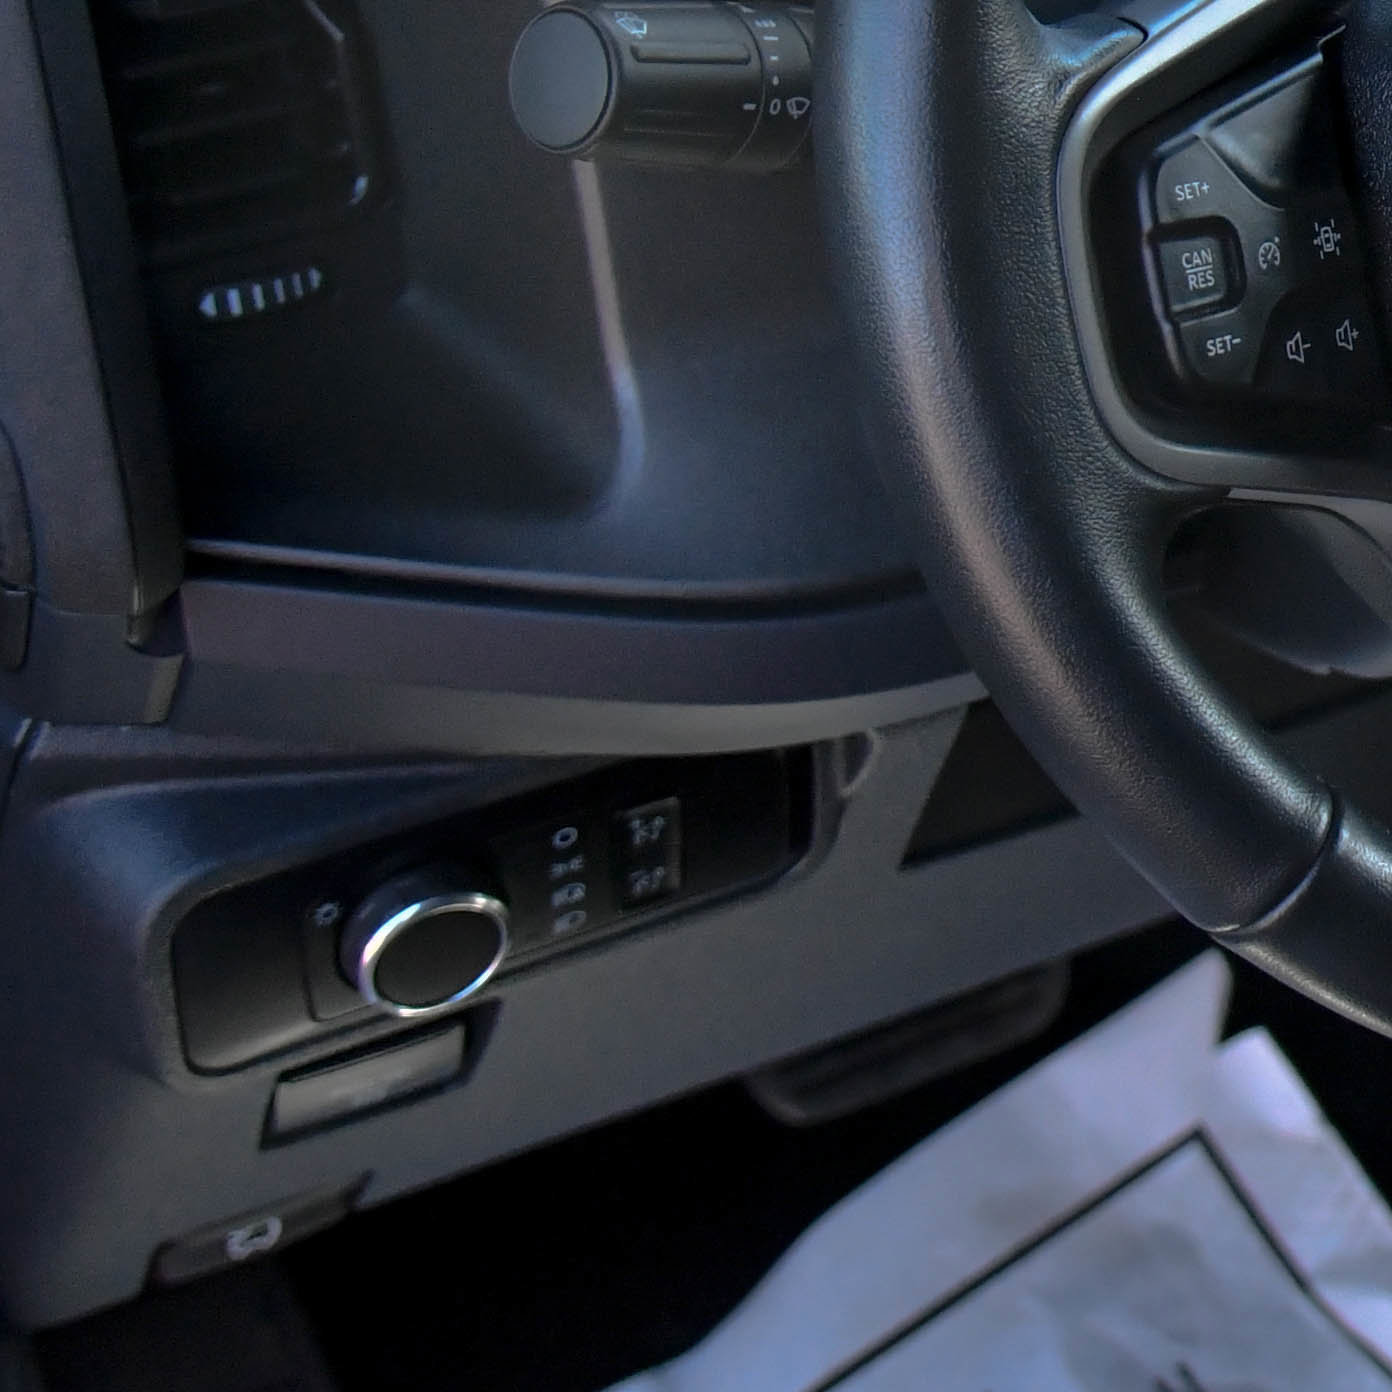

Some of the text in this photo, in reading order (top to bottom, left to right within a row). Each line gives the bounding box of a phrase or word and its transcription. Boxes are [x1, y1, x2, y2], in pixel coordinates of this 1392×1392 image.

[1174, 180, 1211, 203] SET+
[1181, 247, 1213, 268] CAN
[1186, 269, 1216, 291] RES
